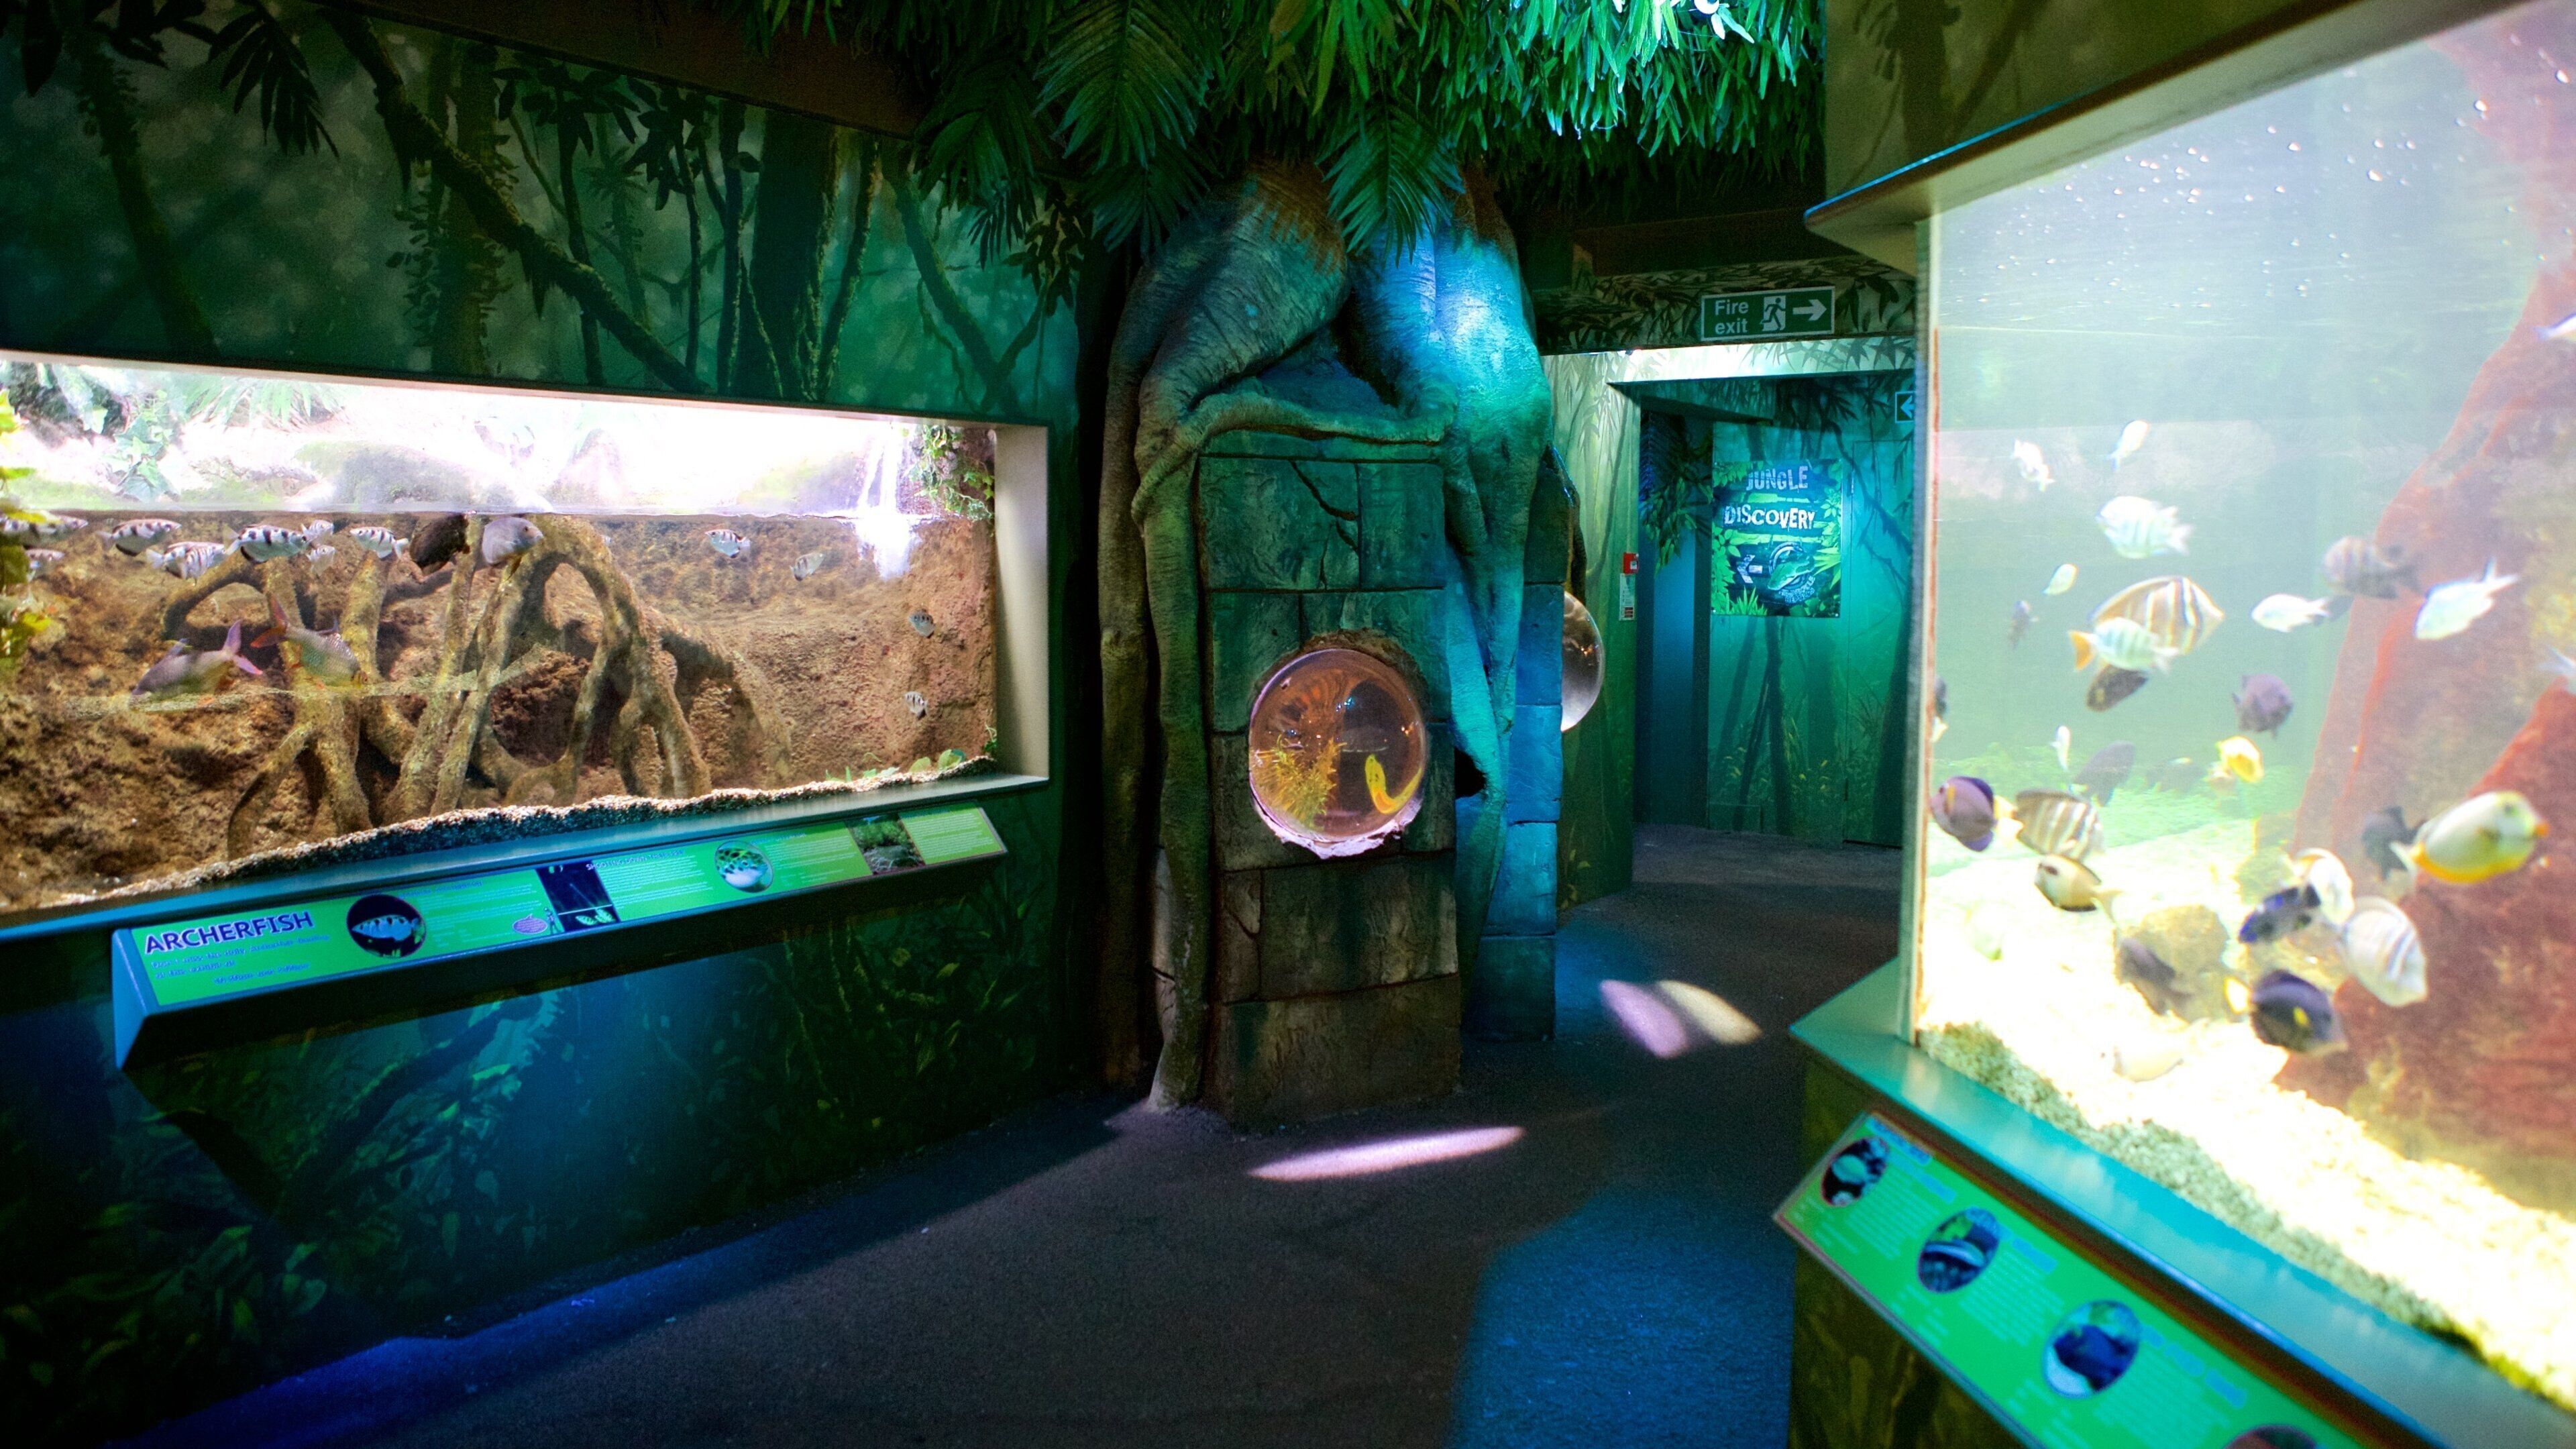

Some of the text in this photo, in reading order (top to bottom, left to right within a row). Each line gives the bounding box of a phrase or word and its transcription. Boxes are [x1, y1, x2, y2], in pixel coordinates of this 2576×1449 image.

[1715, 299, 1748, 315] Fire
[1715, 317, 1748, 335] exit
[1746, 466, 1808, 490] JUNGLE
[1724, 504, 1815, 529] DISCOVERY
[145, 911, 313, 954] ARCHERFISH
